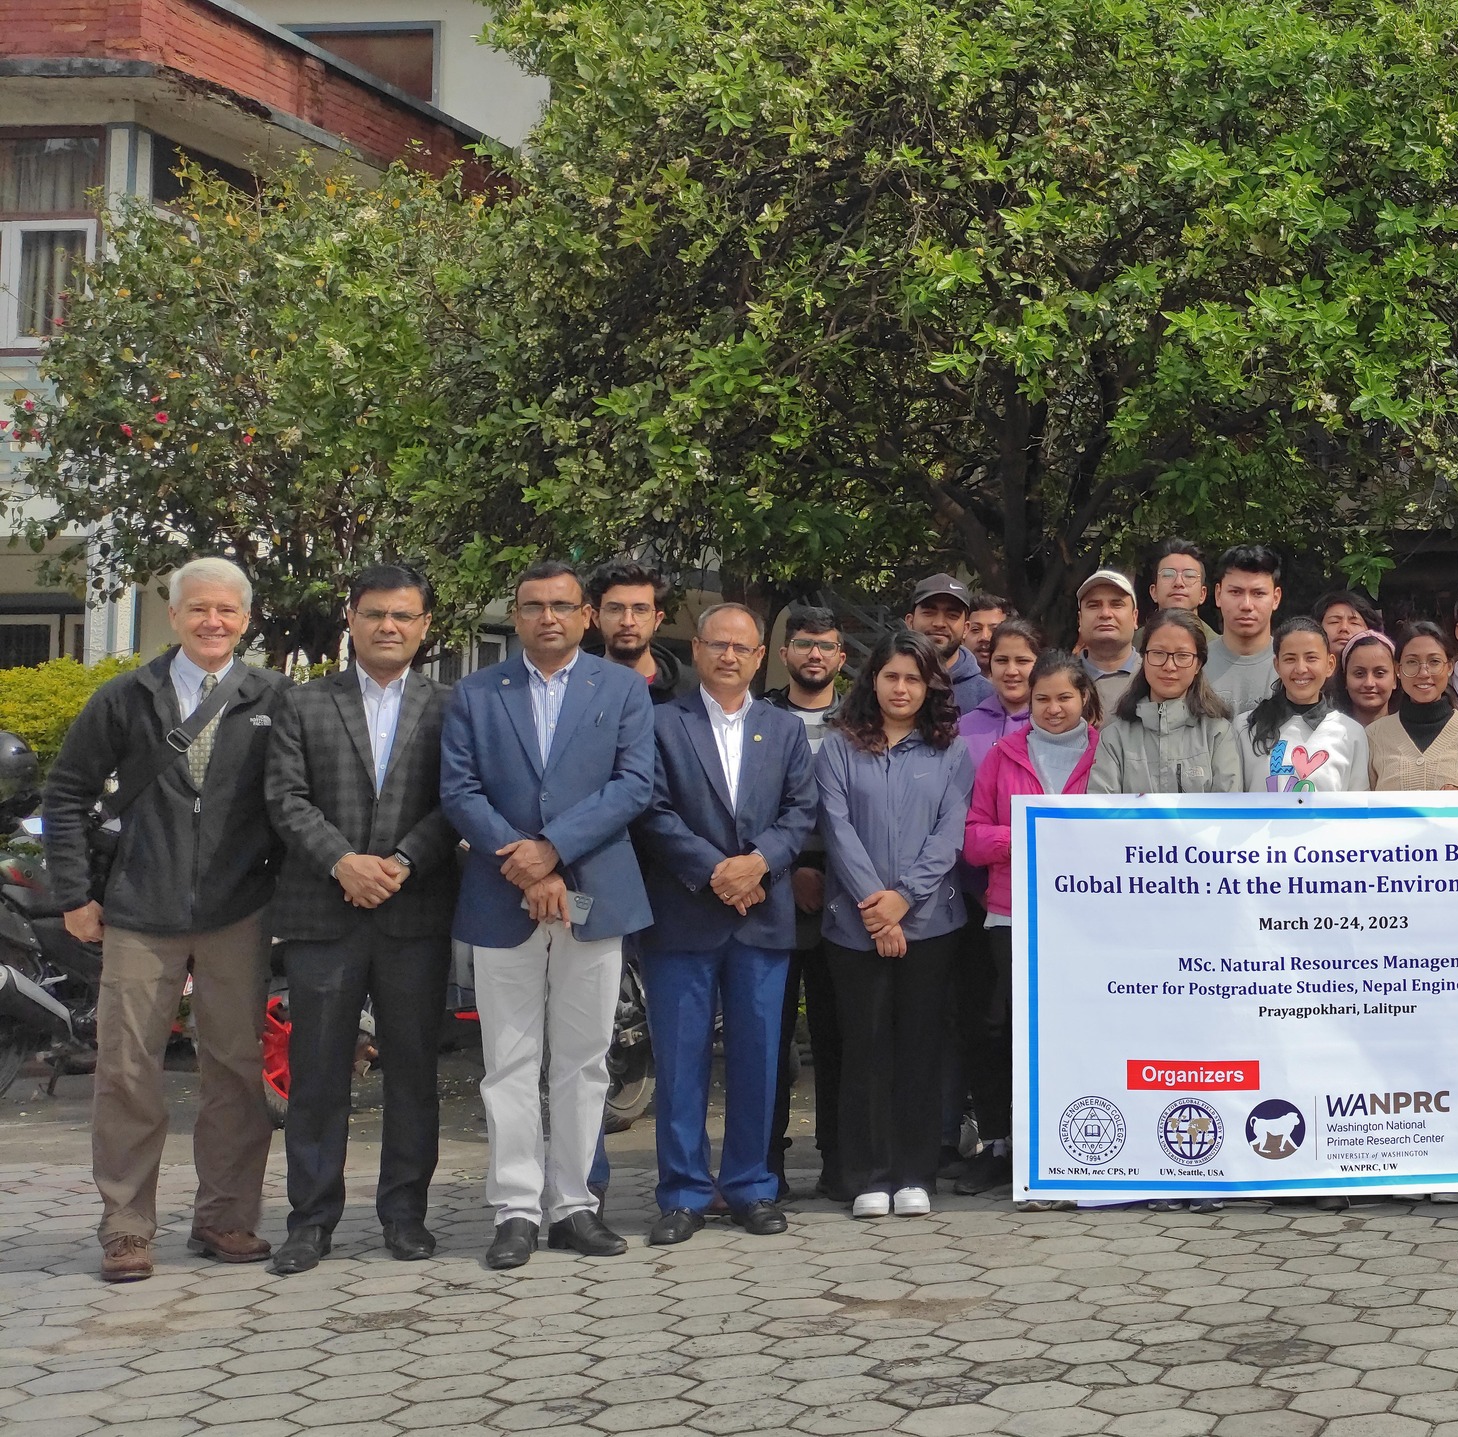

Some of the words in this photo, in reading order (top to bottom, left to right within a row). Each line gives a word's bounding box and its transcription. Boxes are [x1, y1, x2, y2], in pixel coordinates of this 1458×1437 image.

[1124, 845, 1179, 864] Field
[1184, 846, 1260, 864] Course
[1266, 845, 1288, 864] in
[1293, 844, 1439, 864] Conservation
[1054, 874, 1123, 894] Global
[1128, 875, 1200, 895] Health
[1216, 877, 1242, 895] At
[1246, 876, 1282, 895] the
[1258, 916, 1309, 931] March
[1313, 916, 1365, 932] 20-24,
[1368, 915, 1409, 930] 2023
[1178, 957, 1216, 972] MSc.
[1220, 956, 1286, 973] Natural
[1290, 956, 1379, 971] Resources
[1107, 980, 1159, 995] Center
[1162, 981, 1185, 995] for
[1188, 980, 1293, 999] Postgraduate
[1296, 979, 1358, 995] Studies,
[1362, 978, 1408, 996] Nepal
[1258, 1003, 1360, 1020] Prayagpokhari,
[1363, 1002, 1417, 1017] Lalitpur
[1141, 1066, 1244, 1087] Organizers
[1065, 1098, 1112, 1118] ENGINEERING
[1201, 1103, 1215, 1115] FIELD
[1326, 1090, 1450, 1118] WANPRC
[1062, 1120, 1070, 1143] NEPAL
[1110, 1109, 1124, 1143] COLLEGE
[1326, 1123, 1384, 1134] Washington
[1386, 1120, 1426, 1131] National
[1327, 1136, 1364, 1147] Primate
[1366, 1134, 1411, 1146] Research
[1413, 1133, 1445, 1144] Center
[1086, 1154, 1101, 1162] 1994
[1161, 1140, 1185, 1164] UNIVERSITY
[1327, 1152, 1369, 1160] UNIVERSITY
[1381, 1150, 1429, 1158] WASHINGTON
[1048, 1167, 1066, 1175] MSc
[1067, 1167, 1091, 1176] NRM,
[1107, 1168, 1126, 1176] CPS,
[1128, 1168, 1140, 1176] PU
[1159, 1168, 1176, 1177] UW,
[1177, 1168, 1206, 1177] Seattle,
[1207, 1169, 1225, 1177] USA
[1340, 1164, 1381, 1173] WANPRC,
[1383, 1163, 1398, 1171] UW
